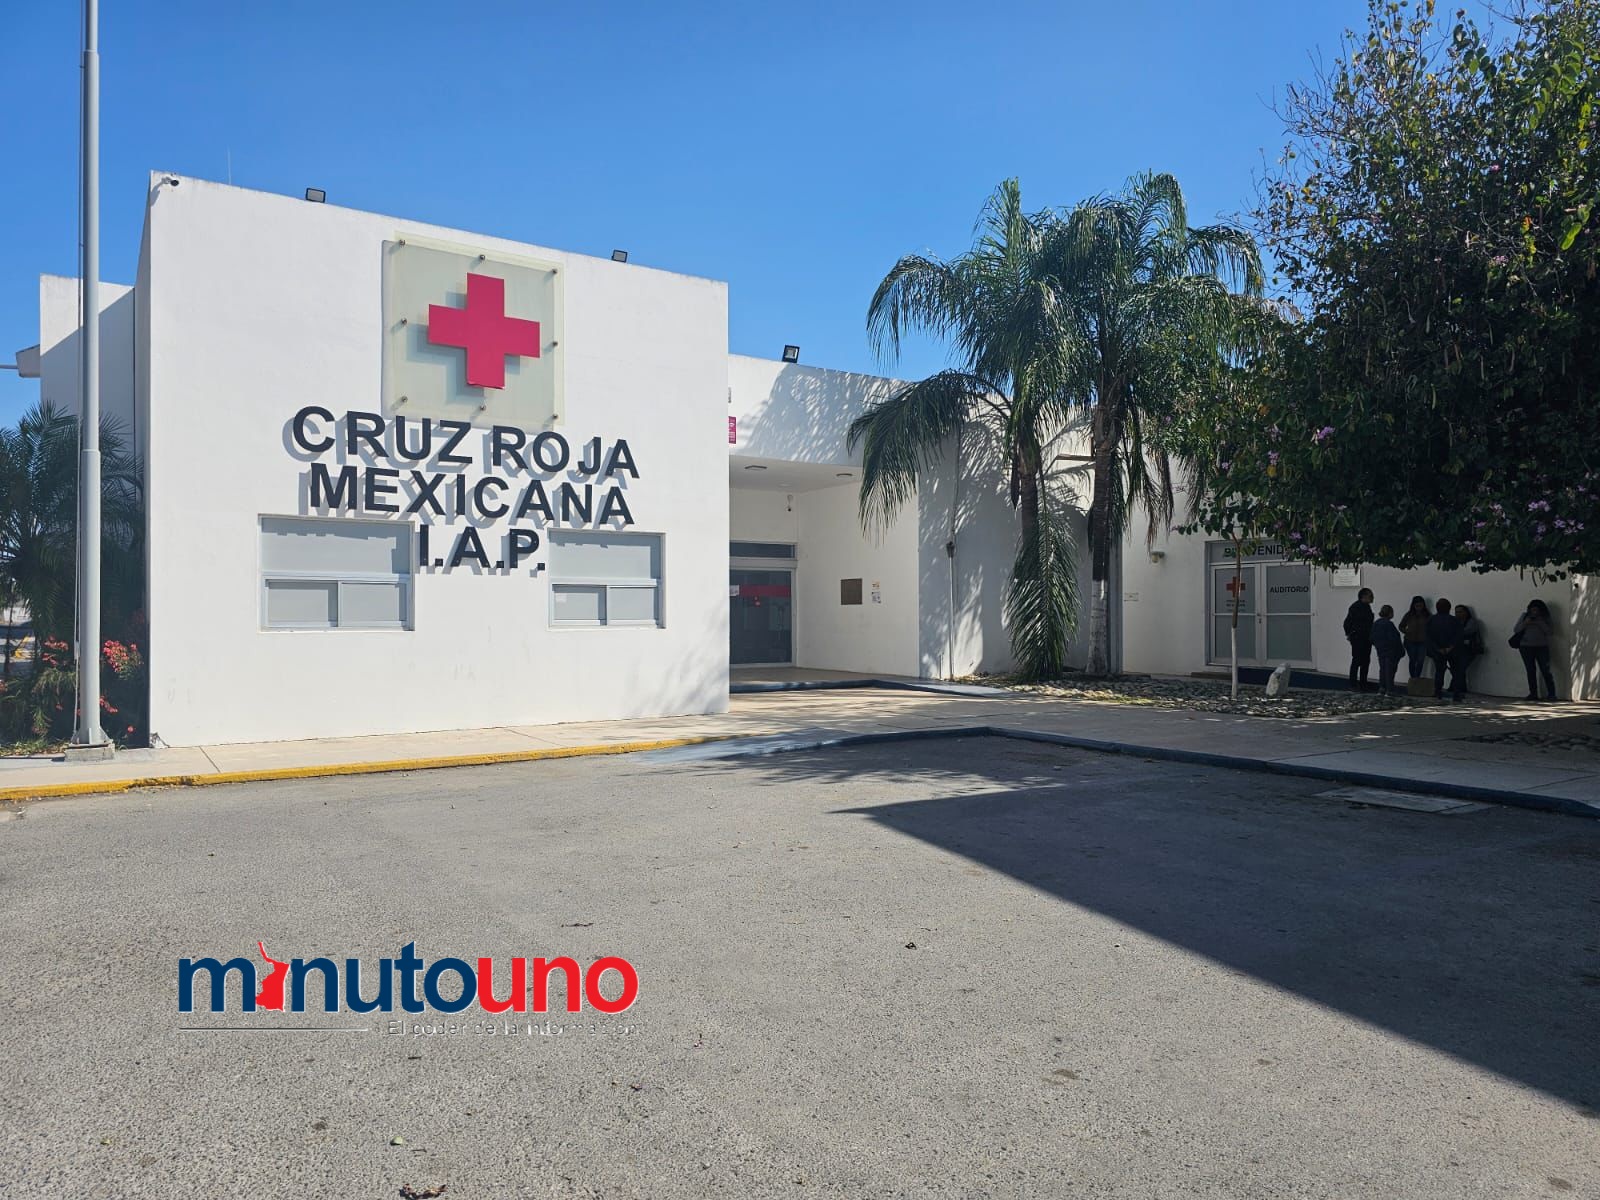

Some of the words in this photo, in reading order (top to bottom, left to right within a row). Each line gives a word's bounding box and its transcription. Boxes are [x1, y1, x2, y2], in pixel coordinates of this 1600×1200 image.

[292, 406, 473, 464] CRUZ
[492, 425, 640, 479] ROJA
[310, 462, 635, 525] MEXICANA
[419, 524, 546, 571] I.A.P.
